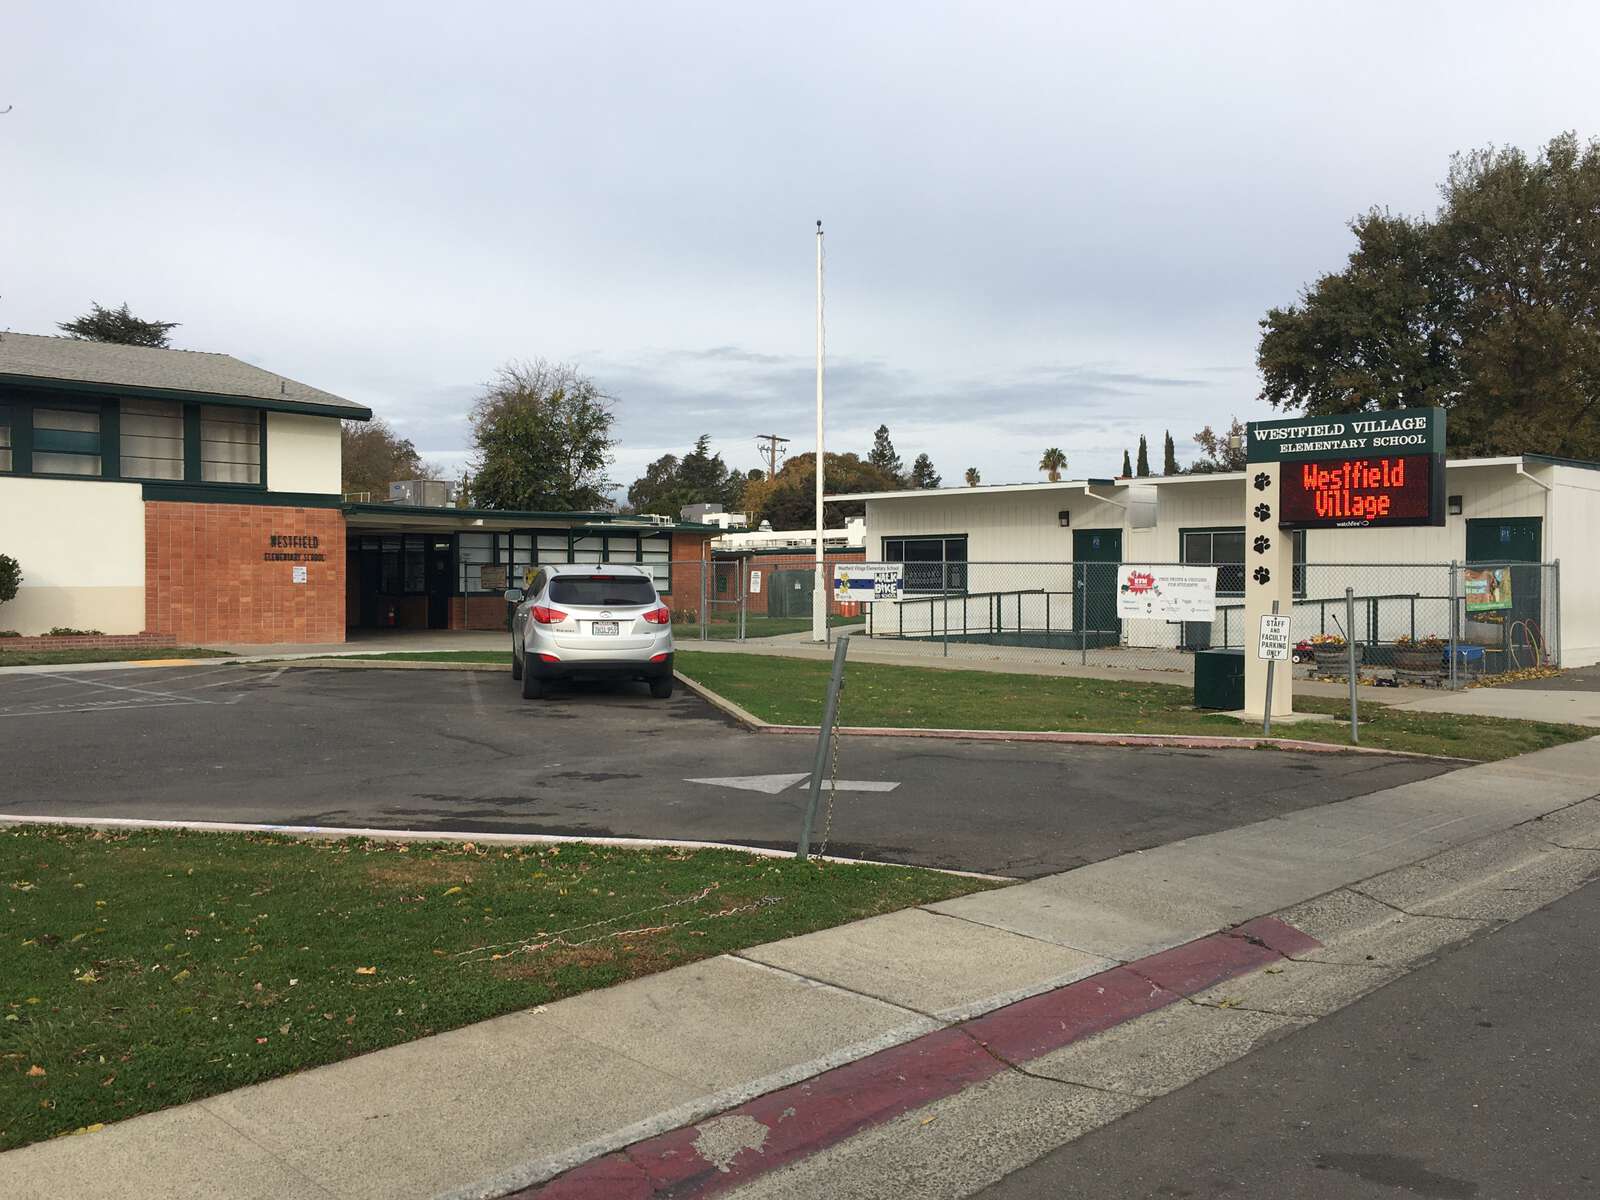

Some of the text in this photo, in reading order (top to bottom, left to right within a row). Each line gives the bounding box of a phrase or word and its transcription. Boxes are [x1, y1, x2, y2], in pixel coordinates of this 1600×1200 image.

[1254, 416, 1426, 441] WESTFIELD VILLAGE
[1280, 434, 1426, 453] ELEMENTARY SCHOOL
[1303, 458, 1404, 490] Westfield
[1315, 489, 1390, 520] Village
[270, 535, 319, 549] WESTFIELD
[304, 553, 325, 562] SCHOOL
[875, 572, 897, 583] WALK
[875, 583, 897, 594] BIKE
[1262, 634, 1287, 642] FACULTY
[1262, 641, 1286, 650] PARKING
[1267, 649, 1281, 657] ONLY
